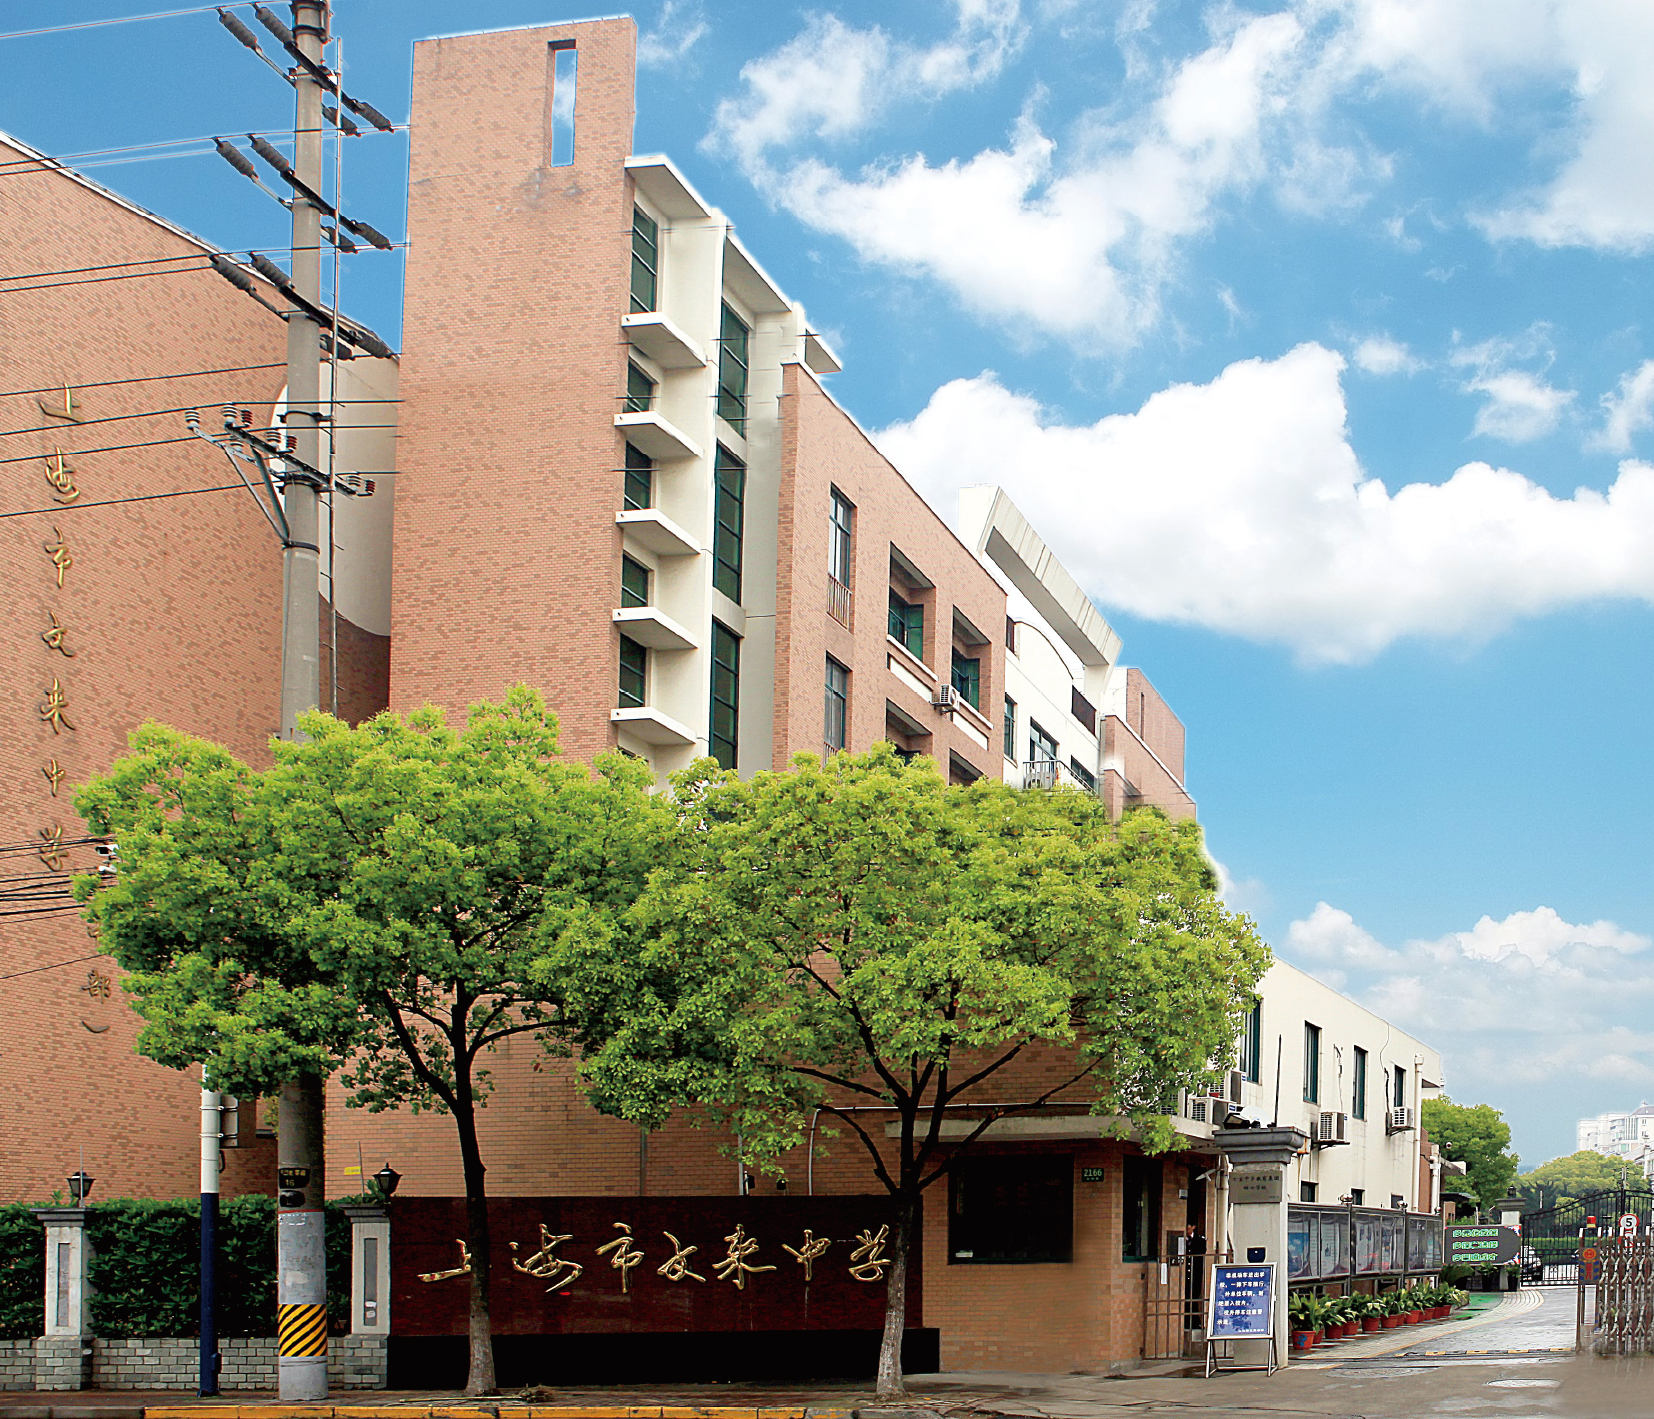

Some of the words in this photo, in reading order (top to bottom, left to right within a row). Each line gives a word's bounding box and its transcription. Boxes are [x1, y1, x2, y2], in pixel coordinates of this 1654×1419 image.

[1625, 1217, 1633, 1227] 5
[417, 1223, 892, 1294] 上海市文来中学
